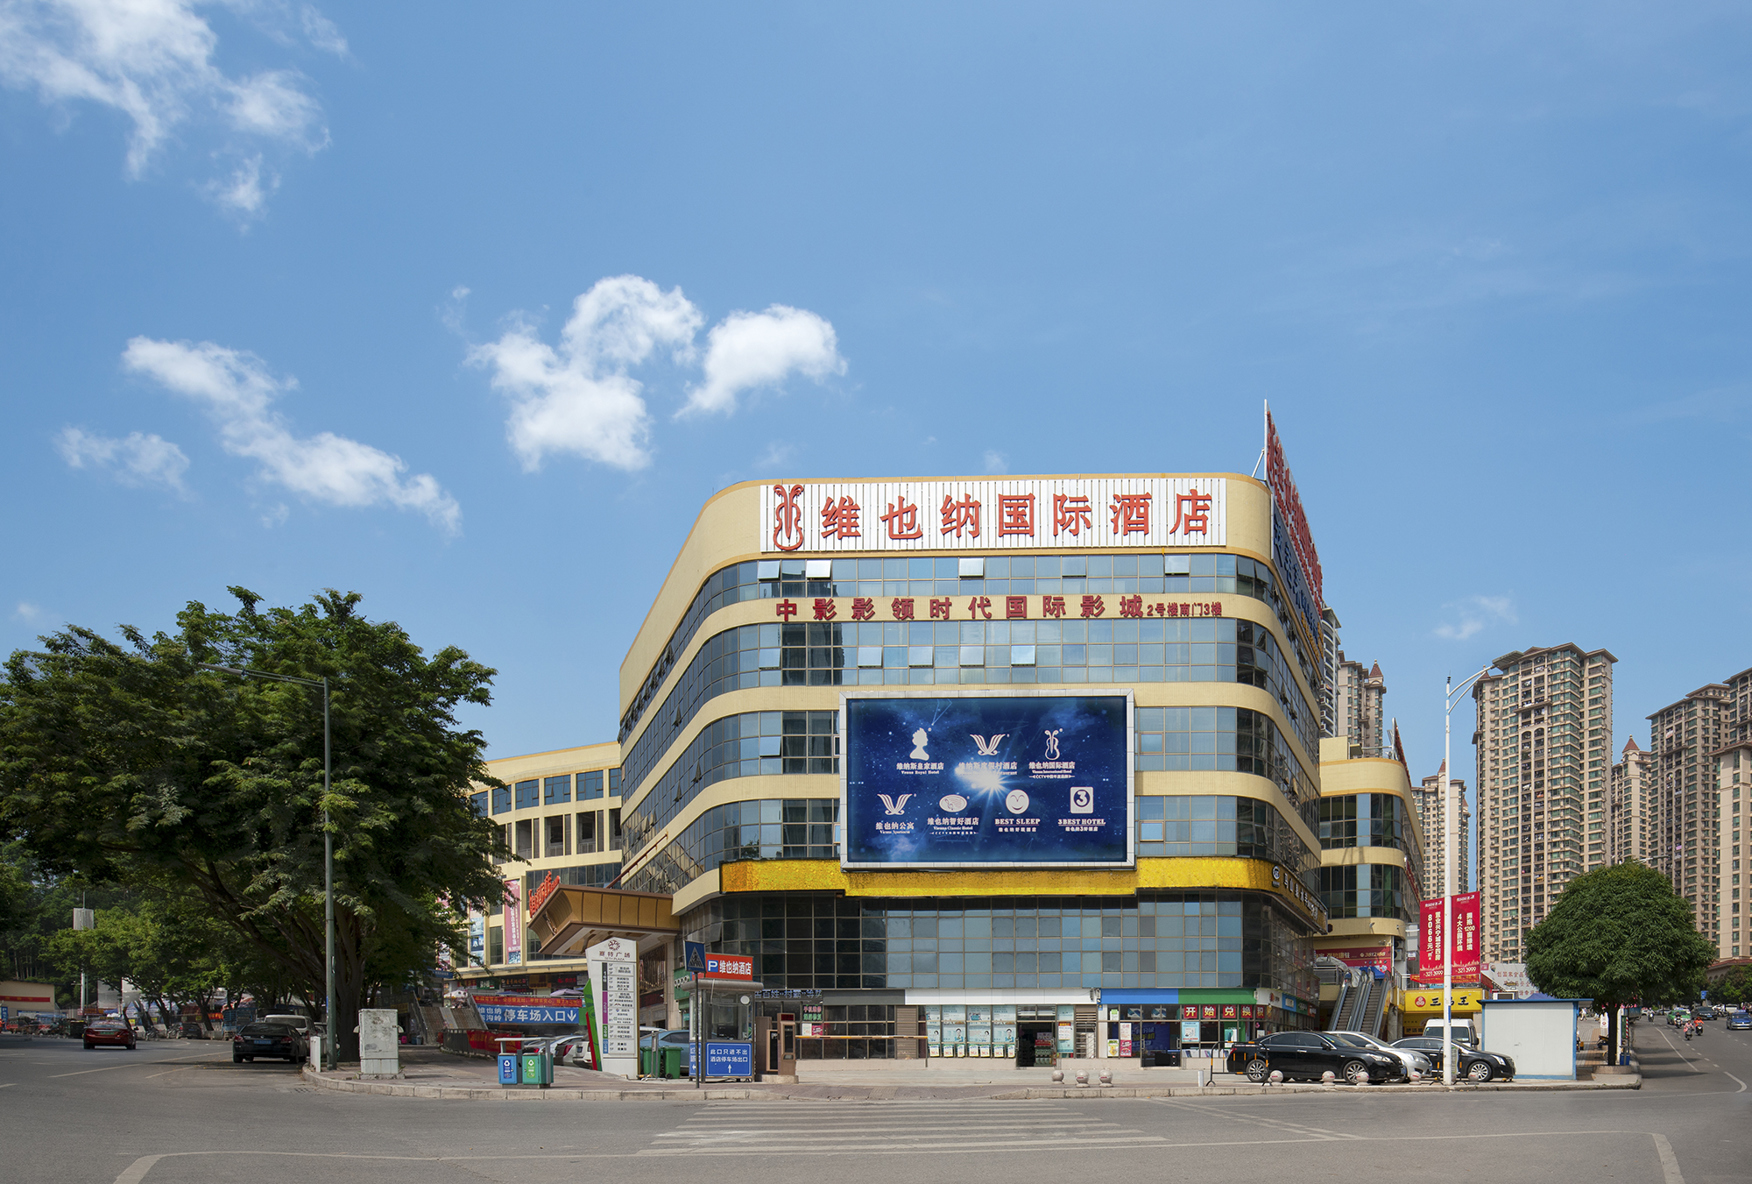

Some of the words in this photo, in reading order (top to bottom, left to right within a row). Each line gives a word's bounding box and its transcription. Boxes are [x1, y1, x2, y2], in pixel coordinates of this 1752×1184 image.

[820, 488, 1213, 540] 维也纳国际酒店
[776, 595, 1143, 622] 中影影领时代国际影城
[1146, 602, 1222, 617] 2号楼南门3楼
[708, 961, 718, 971] P
[719, 960, 752, 975] 维也纳酒店
[1430, 996, 1469, 1006] 三王
[504, 1008, 565, 1022] 停车场入口
